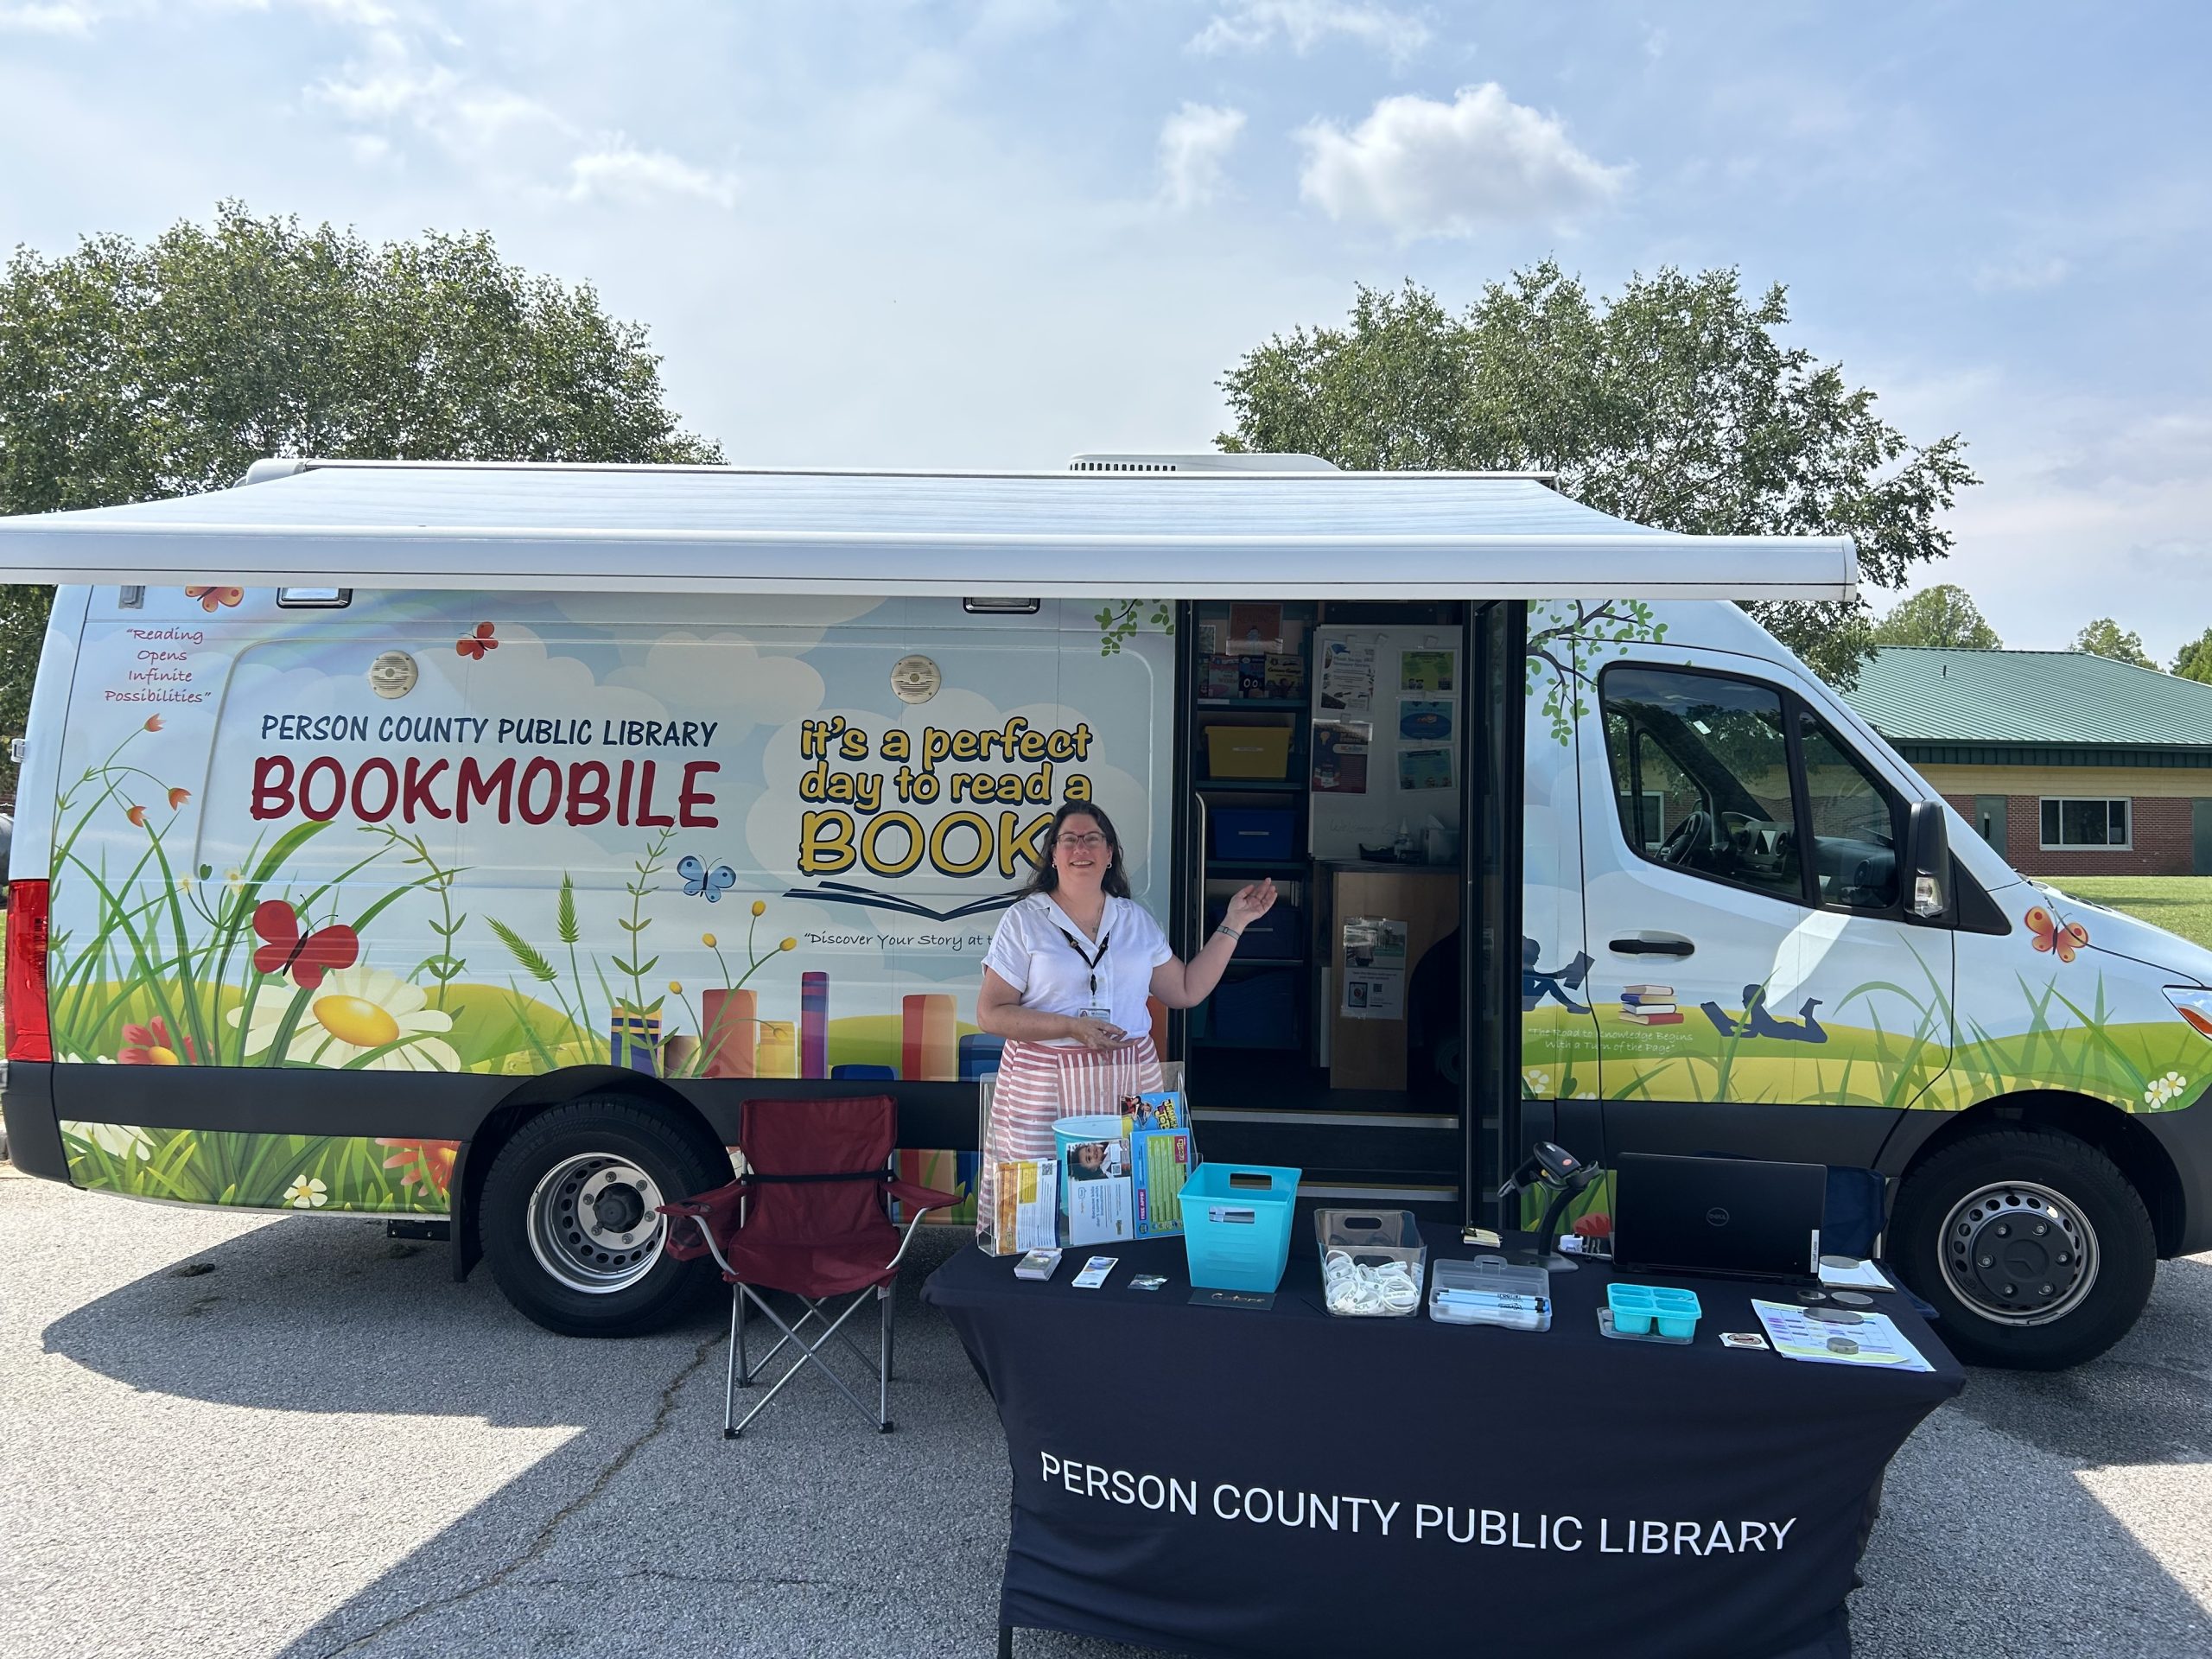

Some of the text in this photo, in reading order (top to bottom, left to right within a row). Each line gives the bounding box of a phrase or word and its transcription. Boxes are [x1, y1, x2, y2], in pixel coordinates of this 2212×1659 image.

[126, 626, 204, 645] “Reading
[137, 650, 188, 664] Opens
[128, 667, 193, 685] Infinite
[105, 688, 212, 703] Possibilities”
[262, 715, 719, 747] PERSON COUNTY PUBLIC LIBRARY
[800, 715, 1093, 772] it’s a perfect
[250, 755, 721, 828] BOOKMOBILE
[799, 760, 1093, 816] day to read a
[798, 809, 1054, 880] BOOK
[804, 931, 874, 944] “Discover
[877, 934, 915, 950] Your
[918, 935, 963, 951] Story
[968, 936, 986, 945] at
[1545, 1039, 1572, 1049] With
[1613, 1041, 1626, 1053] of
[1627, 1042, 1642, 1052] the
[1554, 1028, 1580, 1038] Road
[1656, 1031, 1694, 1044] Begins
[1040, 1451, 1797, 1556] PERSON COUNTY PUBLIC LIBRARY
